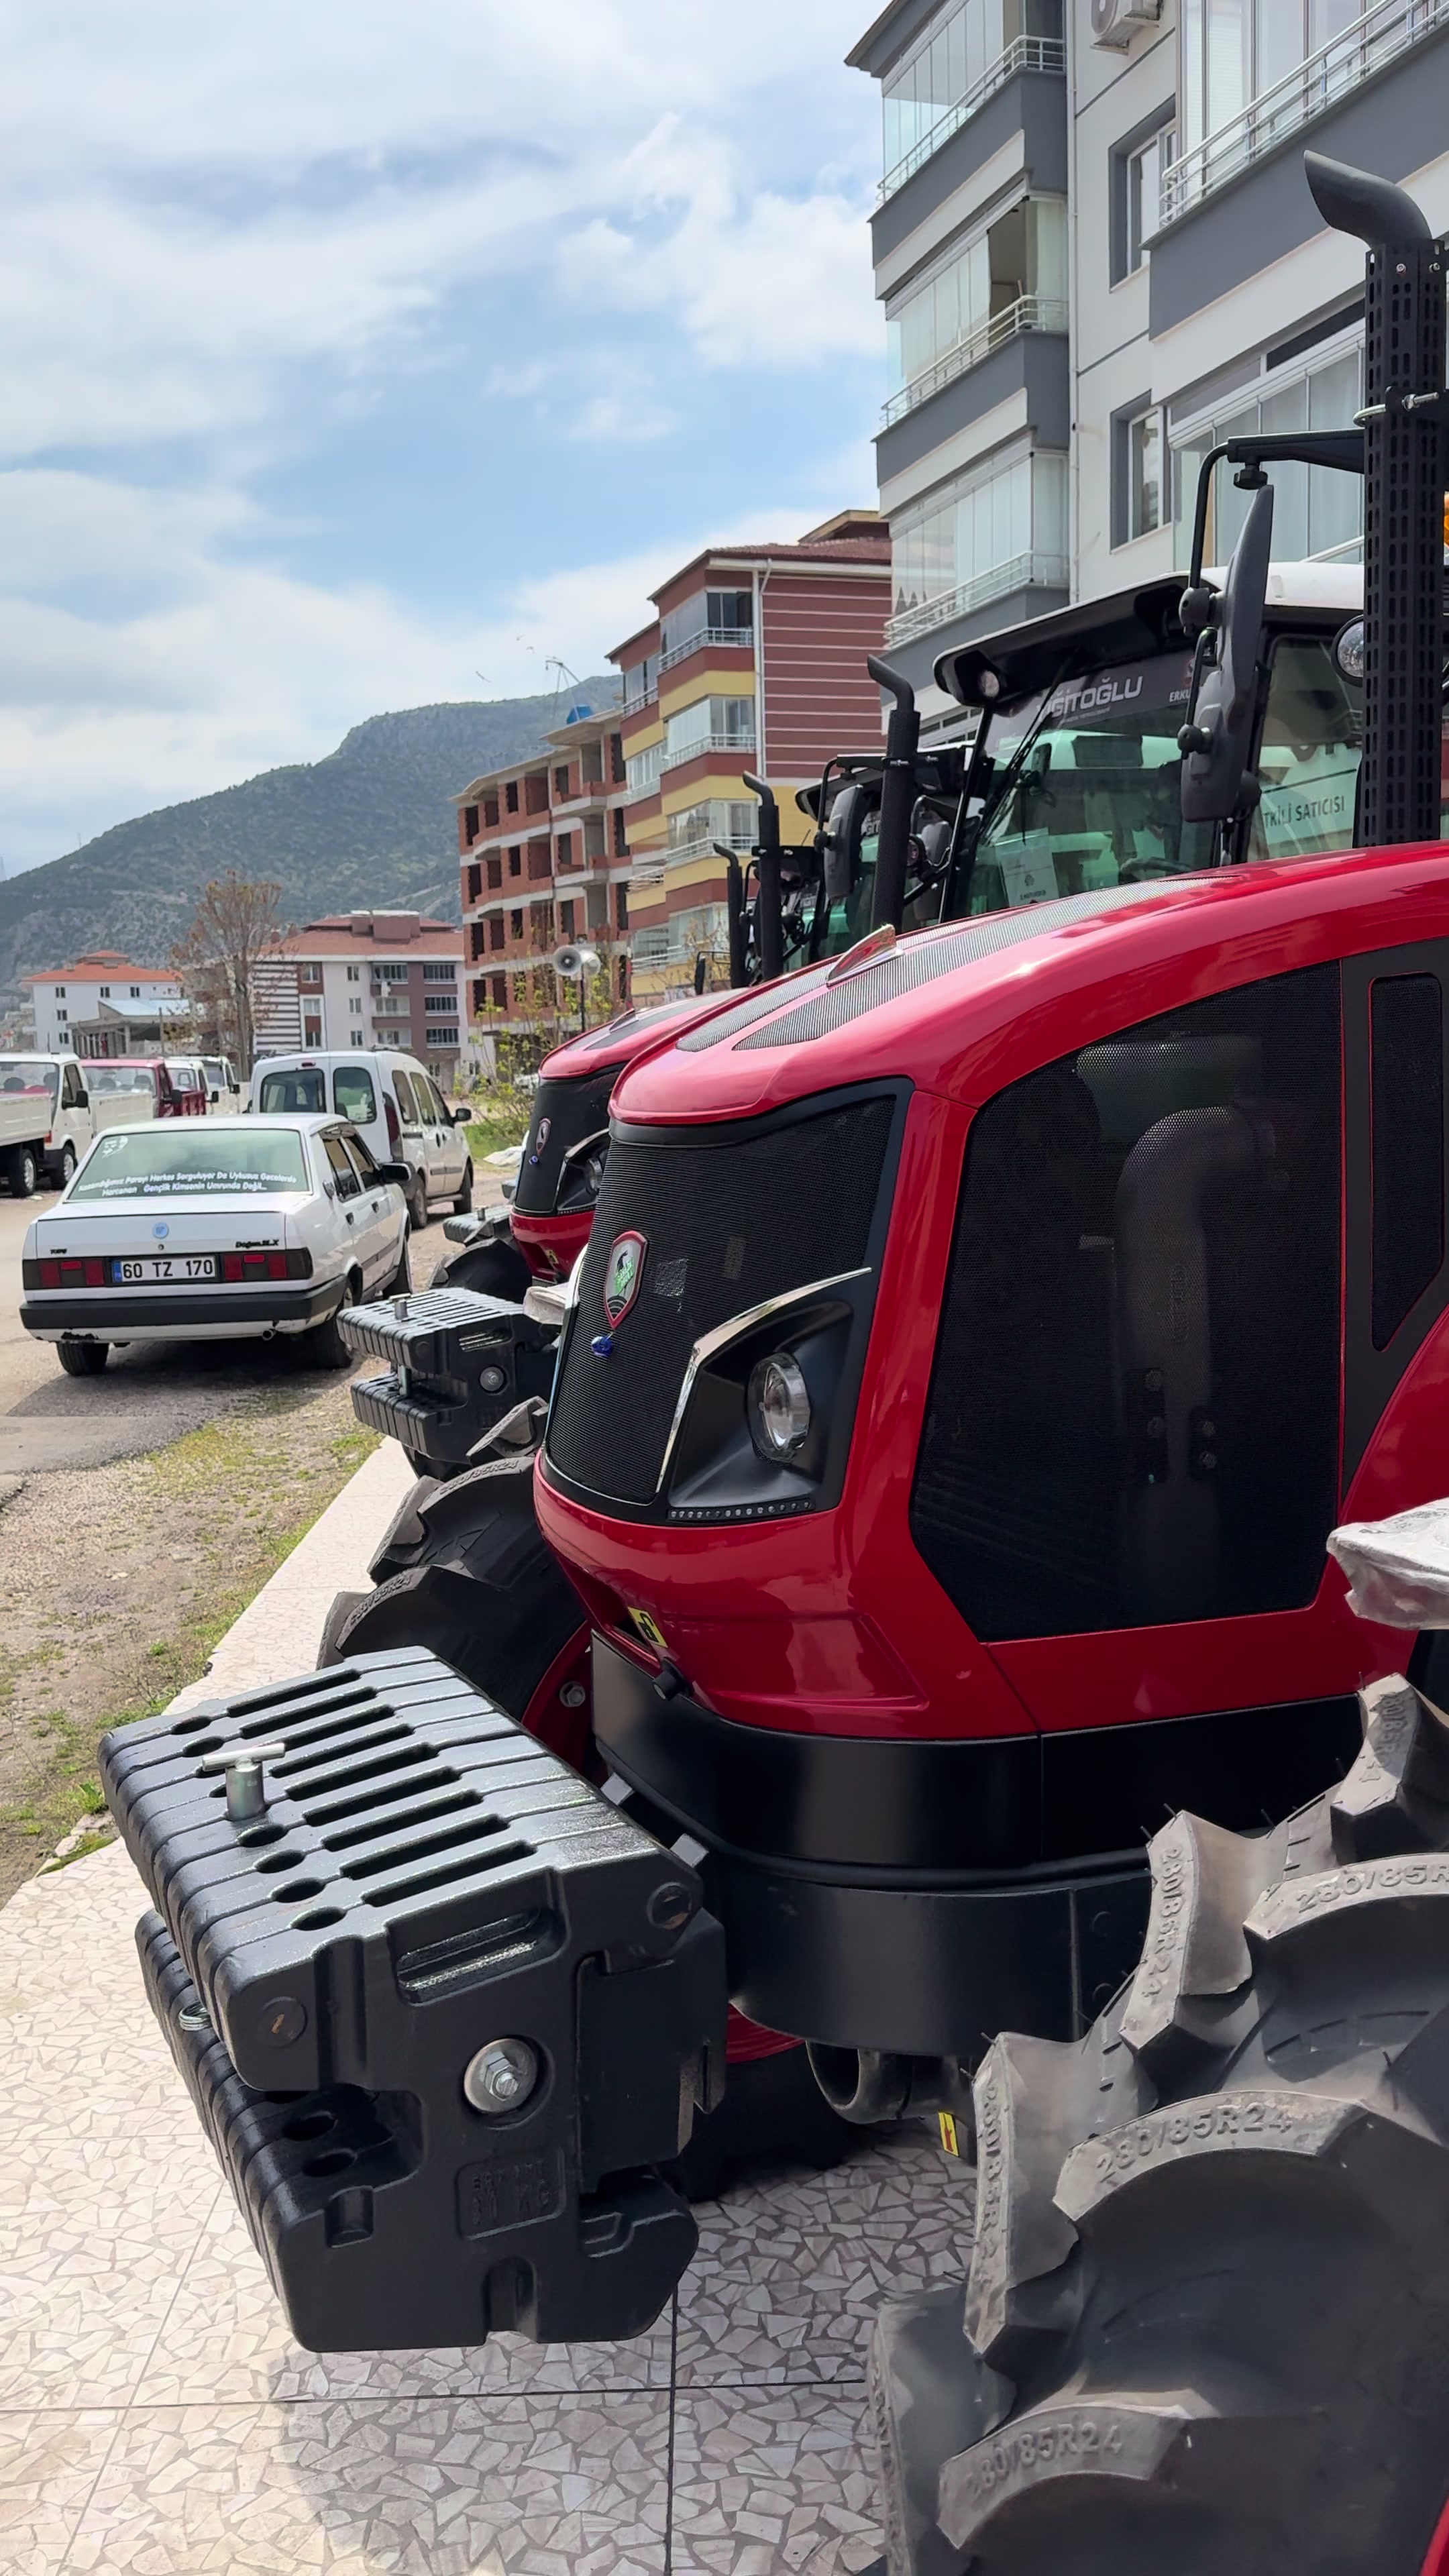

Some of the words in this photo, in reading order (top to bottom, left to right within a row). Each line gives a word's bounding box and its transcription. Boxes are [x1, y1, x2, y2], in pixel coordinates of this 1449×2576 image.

[1036, 676, 1143, 718] ĞİTOĞLU
[1169, 690, 1191, 702] ERKU
[1295, 795, 1345, 822] SATICISI
[144, 1183, 170, 1193] Gençlik
[207, 1181, 241, 1190] Umrunda
[150, 1174, 175, 1182] Herkes
[217, 1171, 227, 1179] De
[123, 1263, 143, 1279] 60
[152, 1262, 172, 1277] TZ
[185, 1259, 213, 1276] 170
[1296, 1864, 1449, 1913] 280/85R
[1096, 2101, 1293, 2184] 280/85R24
